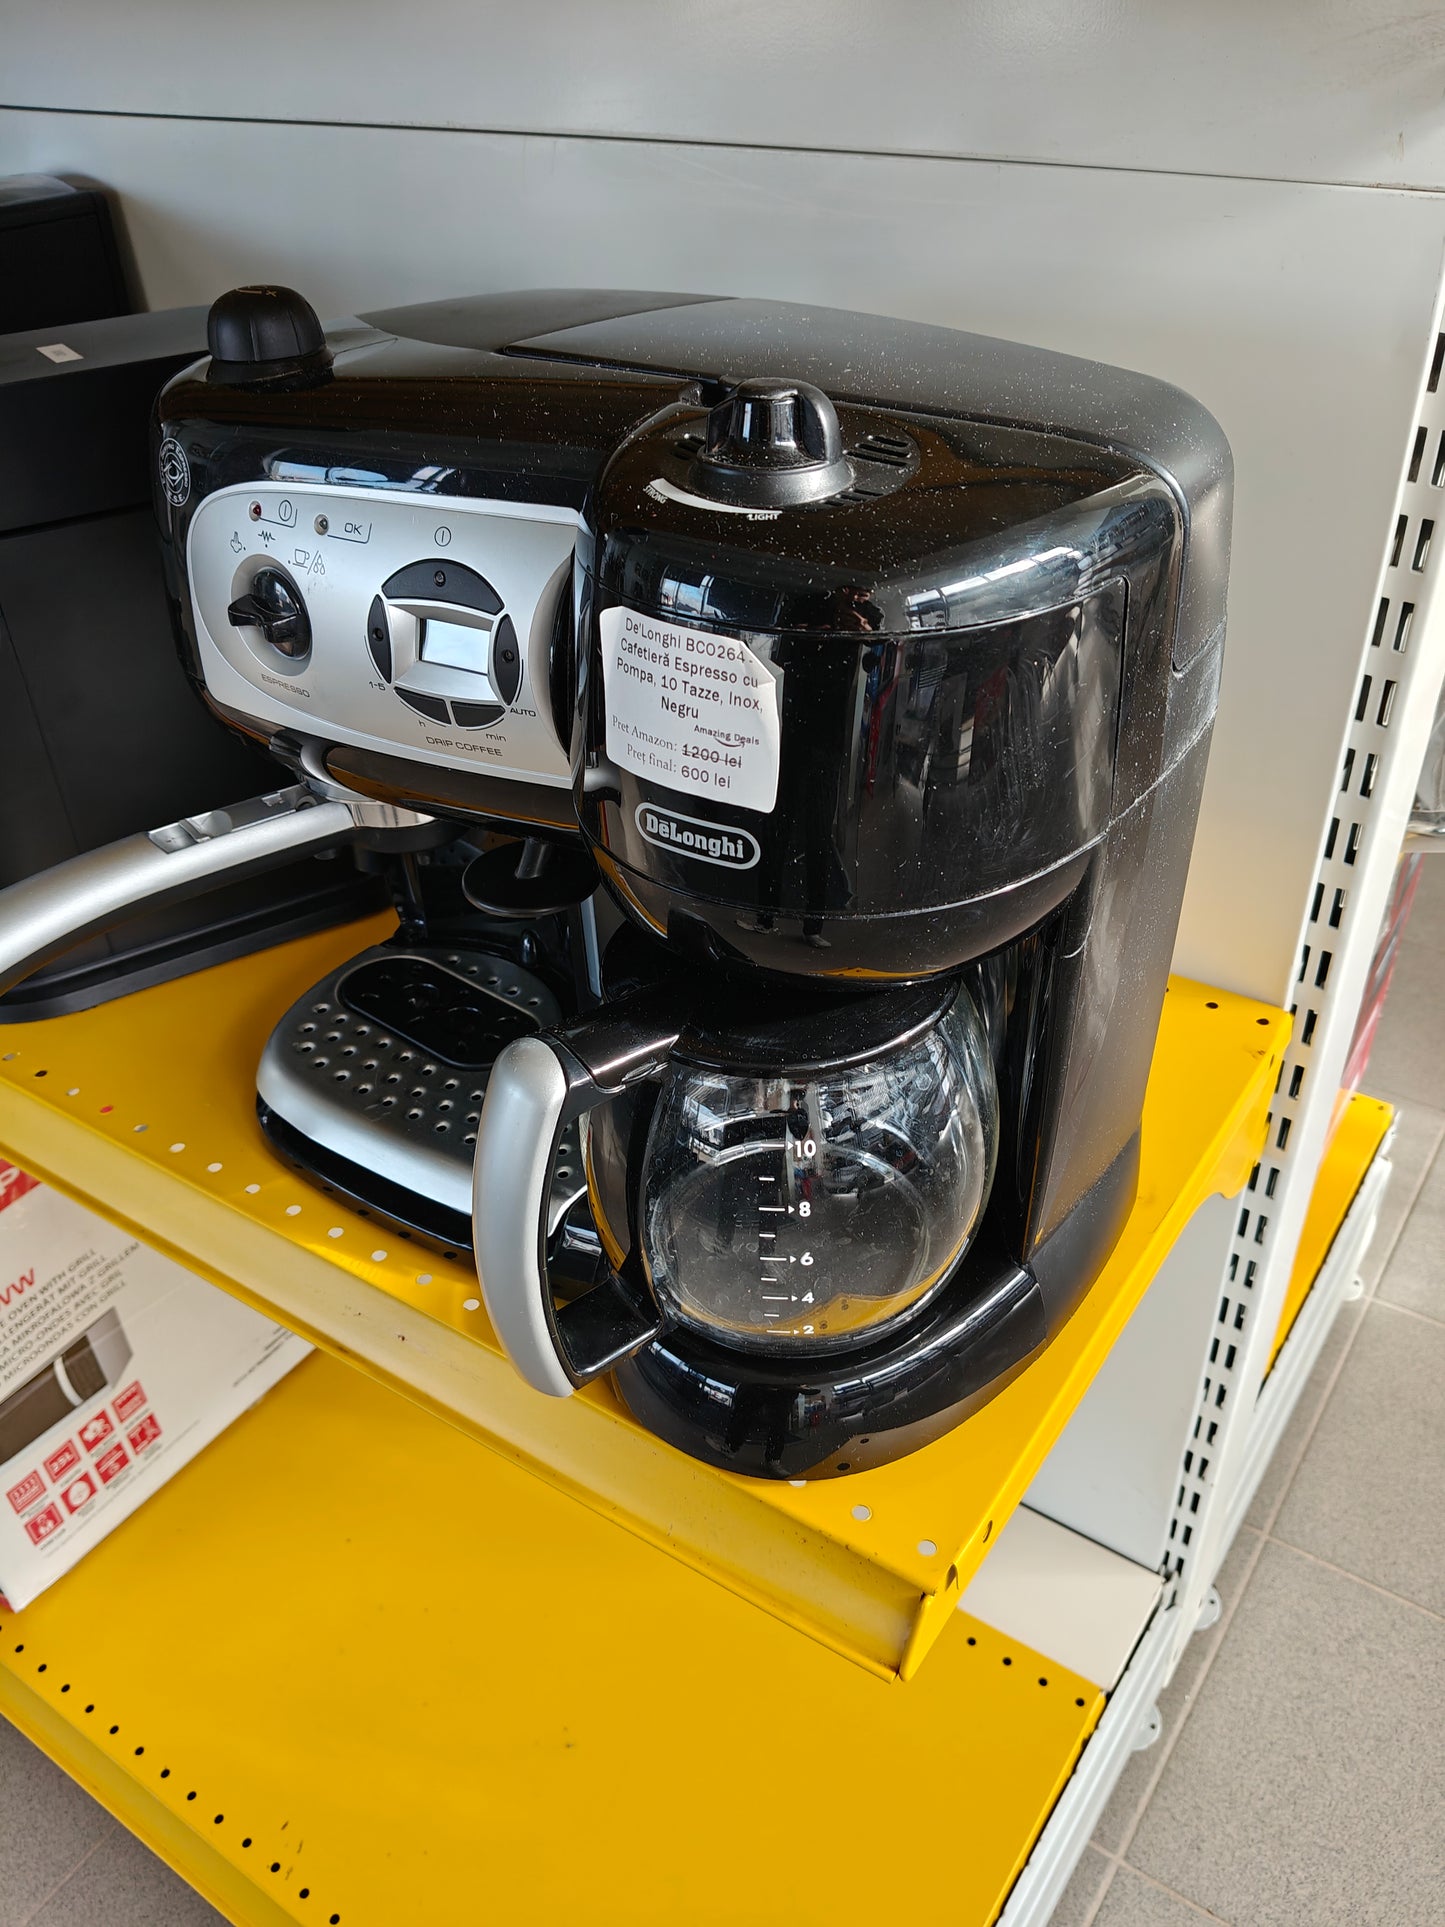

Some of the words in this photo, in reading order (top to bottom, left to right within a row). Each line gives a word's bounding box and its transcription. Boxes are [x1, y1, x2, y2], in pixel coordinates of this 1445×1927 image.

[643, 485, 669, 504] STRONG
[344, 522, 364, 535] OK
[625, 617, 681, 649] De'Longhi
[620, 637, 670, 667] Cafetieră
[674, 656, 738, 684] Espresso
[742, 675, 759, 689] cu
[261, 673, 311, 698] ESPRESSO
[368, 680, 386, 692] 1-5
[616, 656, 657, 688] Pompa,
[661, 675, 678, 691] 10
[681, 680, 724, 706] Tazze,
[729, 691, 763, 714] Inox,
[510, 707, 536, 717] AUTO
[661, 695, 699, 719] Negru
[418, 720, 426, 728] h
[485, 732, 507, 742] min
[693, 724, 731, 742] Amazing
[734, 733, 760, 746] Deals
[425, 736, 453, 747] DRIP
[455, 741, 503, 757] COFFEE
[631, 726, 678, 752] Amazon:
[682, 743, 720, 764] 1200
[724, 753, 742, 769] lei
[649, 752, 677, 774] final:
[681, 765, 709, 784] 600
[714, 772, 731, 789] lei
[794, 1139, 817, 1158] 10
[799, 1201, 811, 1217] 8
[800, 1252, 814, 1266] 6
[8, 1293, 38, 1321] OVEN
[39, 1270, 67, 1295] WITH
[67, 1248, 97, 1273] GRILL
[57, 1276, 77, 1295] MIT
[78, 1255, 107, 1279] GRILL
[801, 1291, 815, 1304] 4
[12, 1284, 87, 1346] MIKROFALOWA
[803, 1325, 815, 1334] 2
[3, 1321, 74, 1381] MICROONDAS
[75, 1302, 99, 1322] CON
